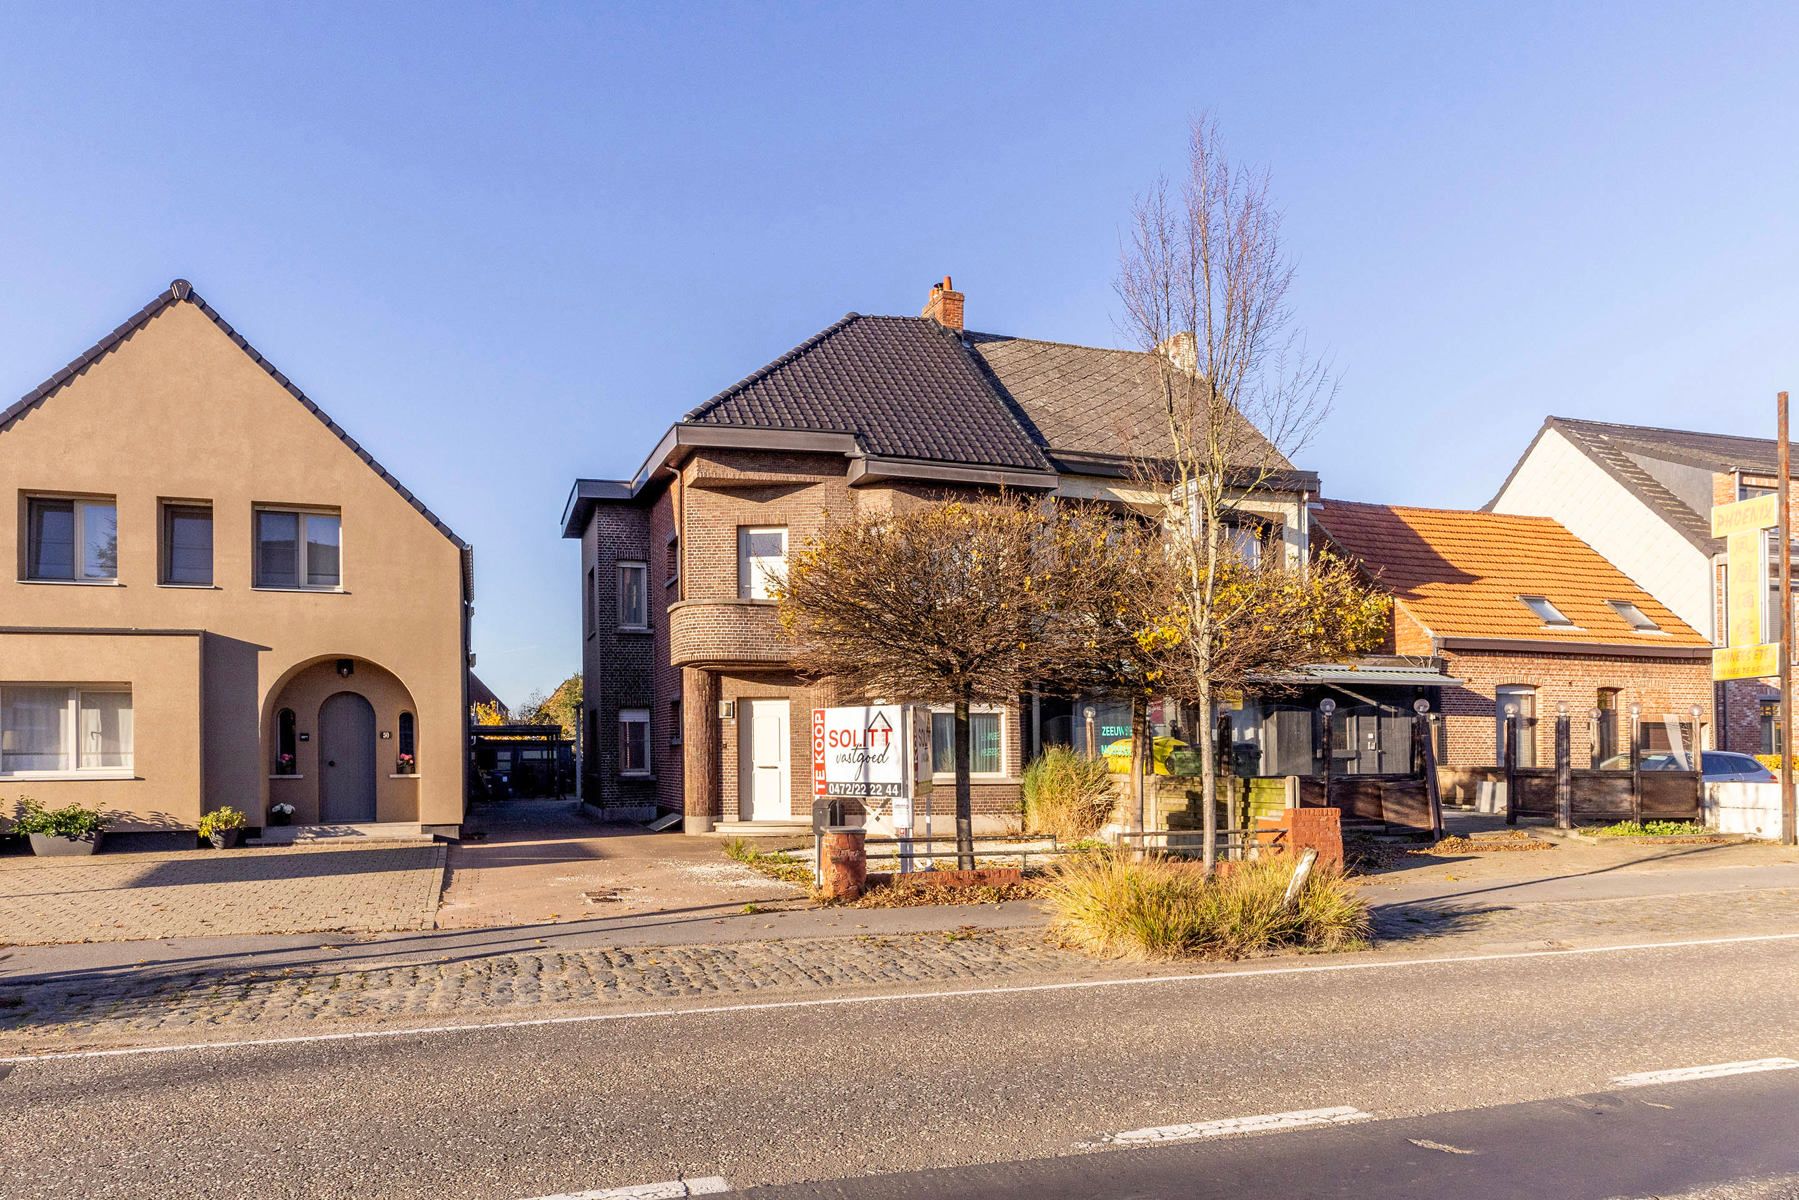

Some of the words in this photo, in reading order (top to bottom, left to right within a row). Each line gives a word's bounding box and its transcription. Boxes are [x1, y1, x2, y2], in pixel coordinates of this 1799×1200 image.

[1717, 503, 1773, 529] PHOENIX
[814, 712, 825, 764] KOOP
[836, 741, 890, 782] vastgoed
[815, 770, 826, 793] TE
[828, 782, 868, 796] 0472/22
[869, 783, 883, 796] 22
[885, 784, 899, 797] 44
